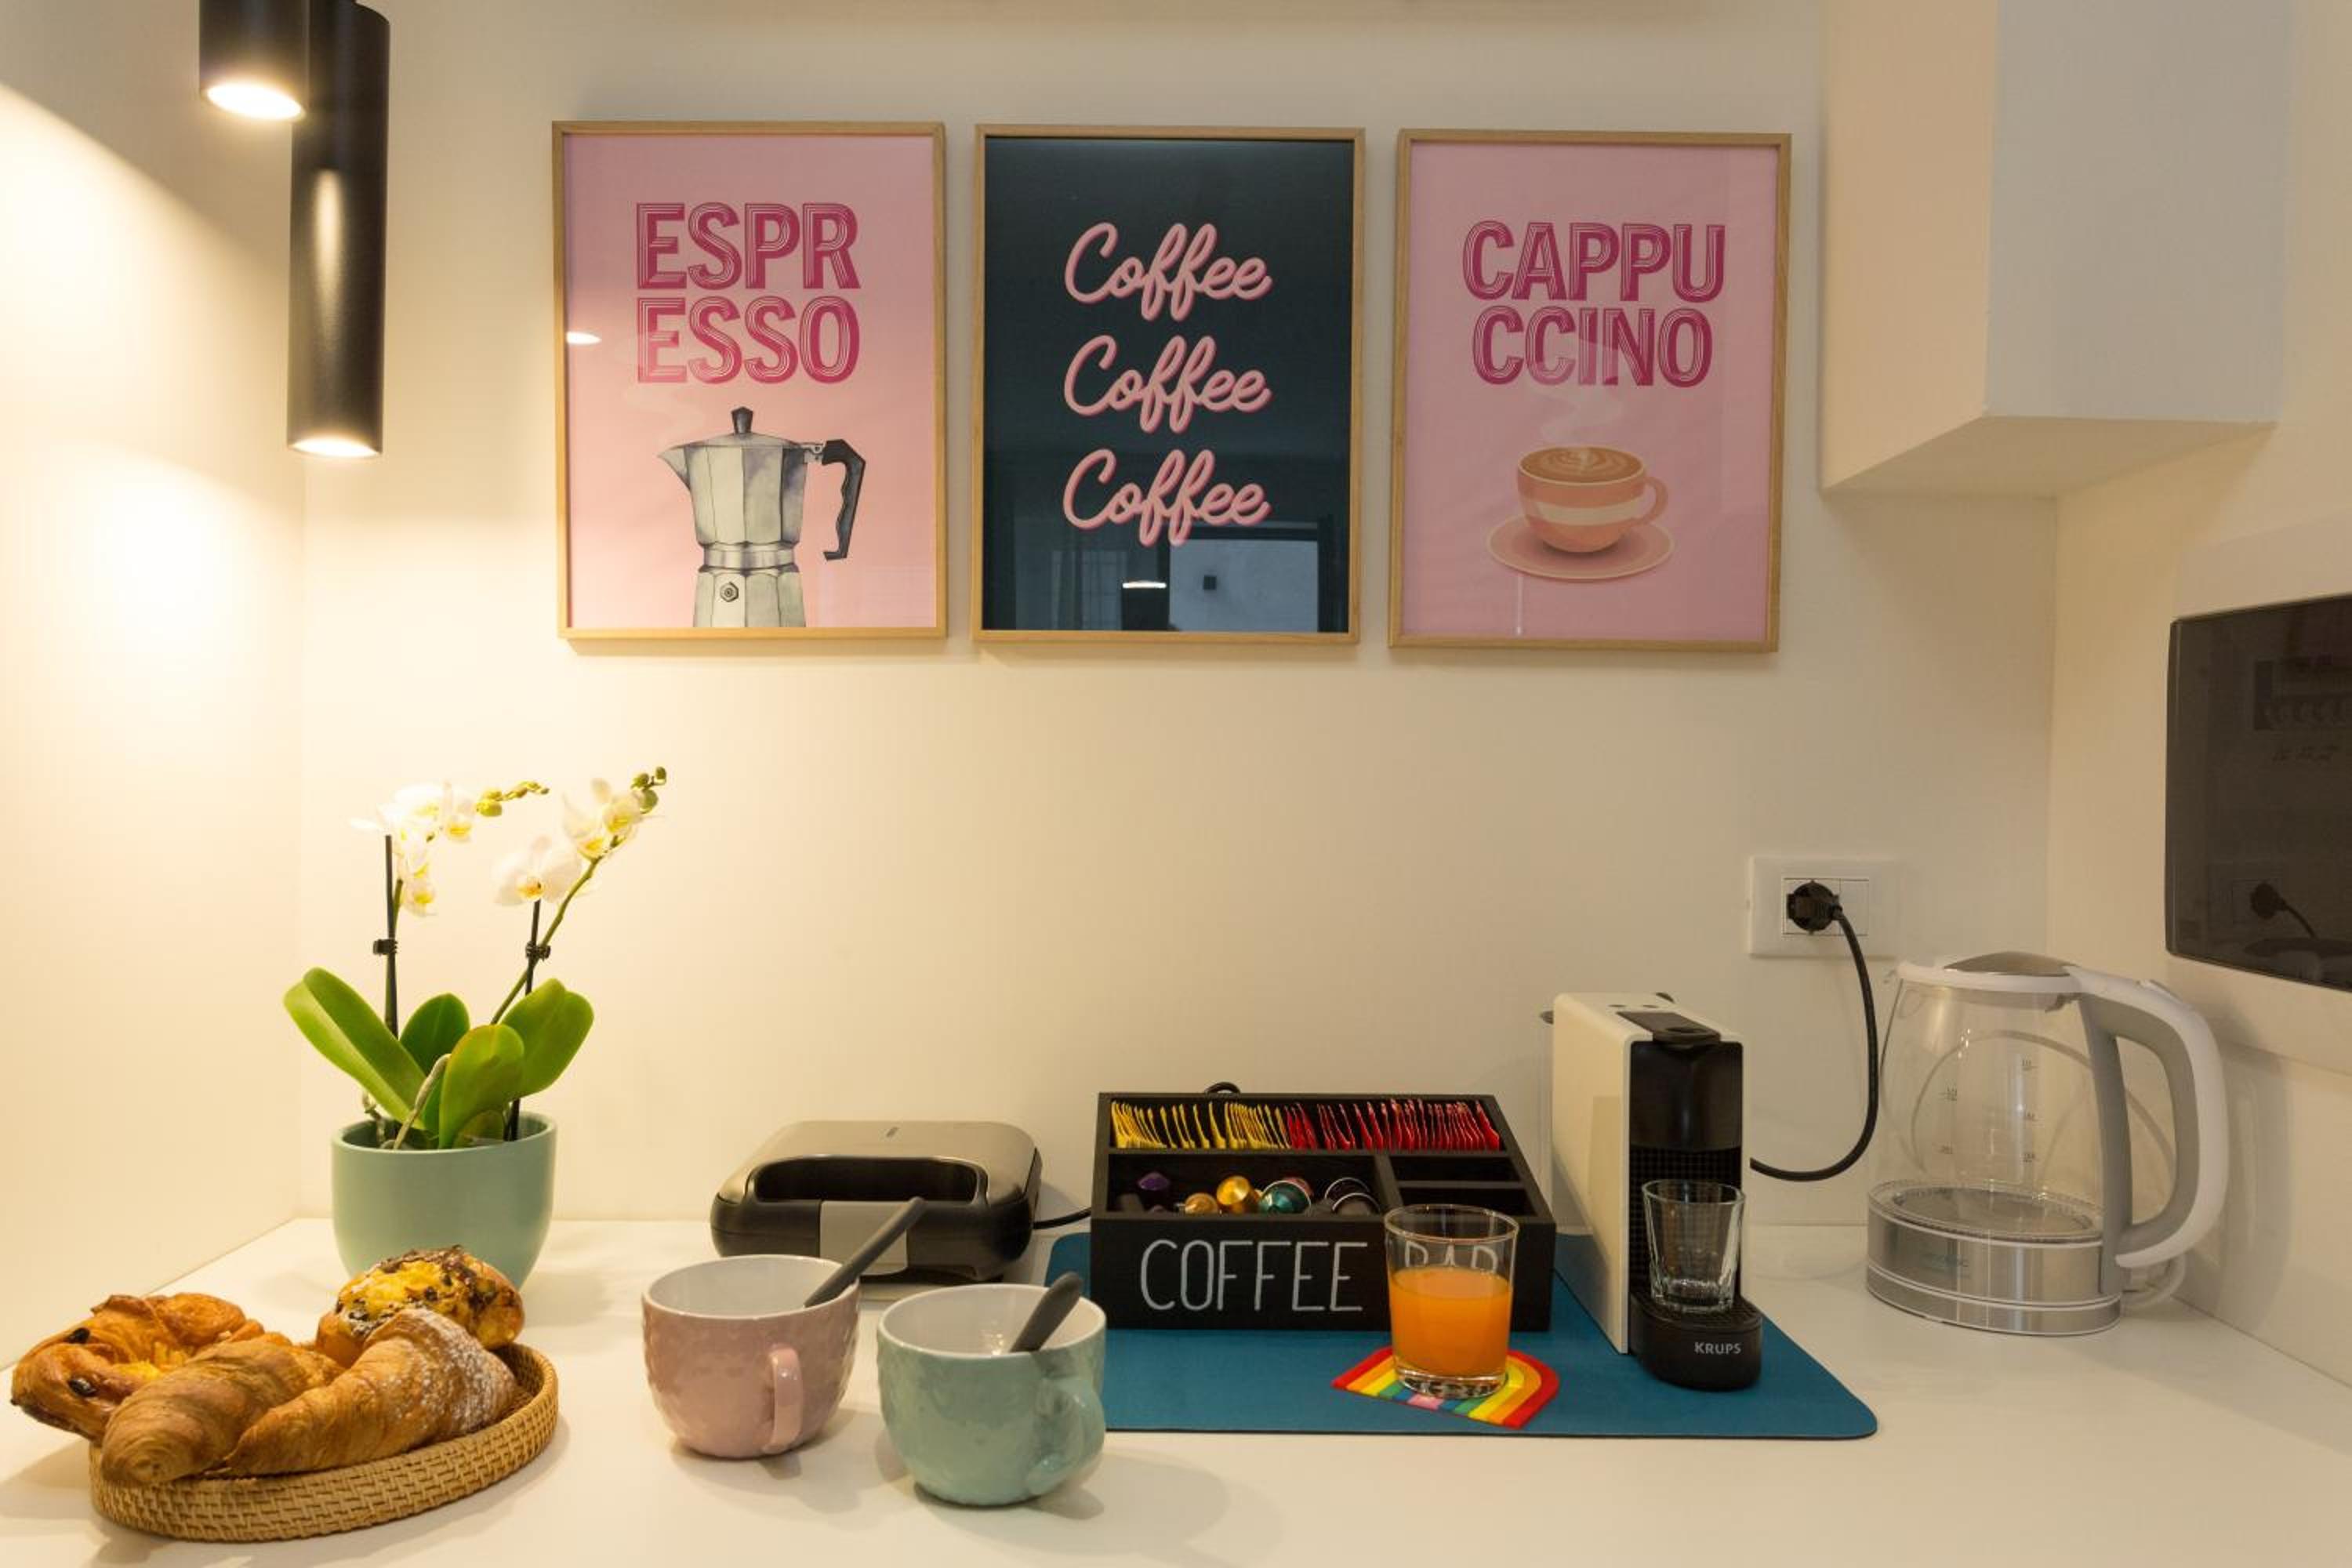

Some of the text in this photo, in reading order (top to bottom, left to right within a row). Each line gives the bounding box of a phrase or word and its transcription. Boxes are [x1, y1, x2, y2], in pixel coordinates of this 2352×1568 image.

[636, 202, 861, 290] ESPR
[1064, 222, 1273, 322] Coffee
[1462, 220, 1726, 303] CAPPU
[636, 296, 861, 384] ESSO
[1063, 334, 1273, 434] Coffee
[1472, 305, 1713, 388] CCINO
[1062, 448, 1272, 547] Coffee
[1141, 1240, 1367, 1311] COFFEE
[1694, 1341, 1741, 1355] KRUPS
